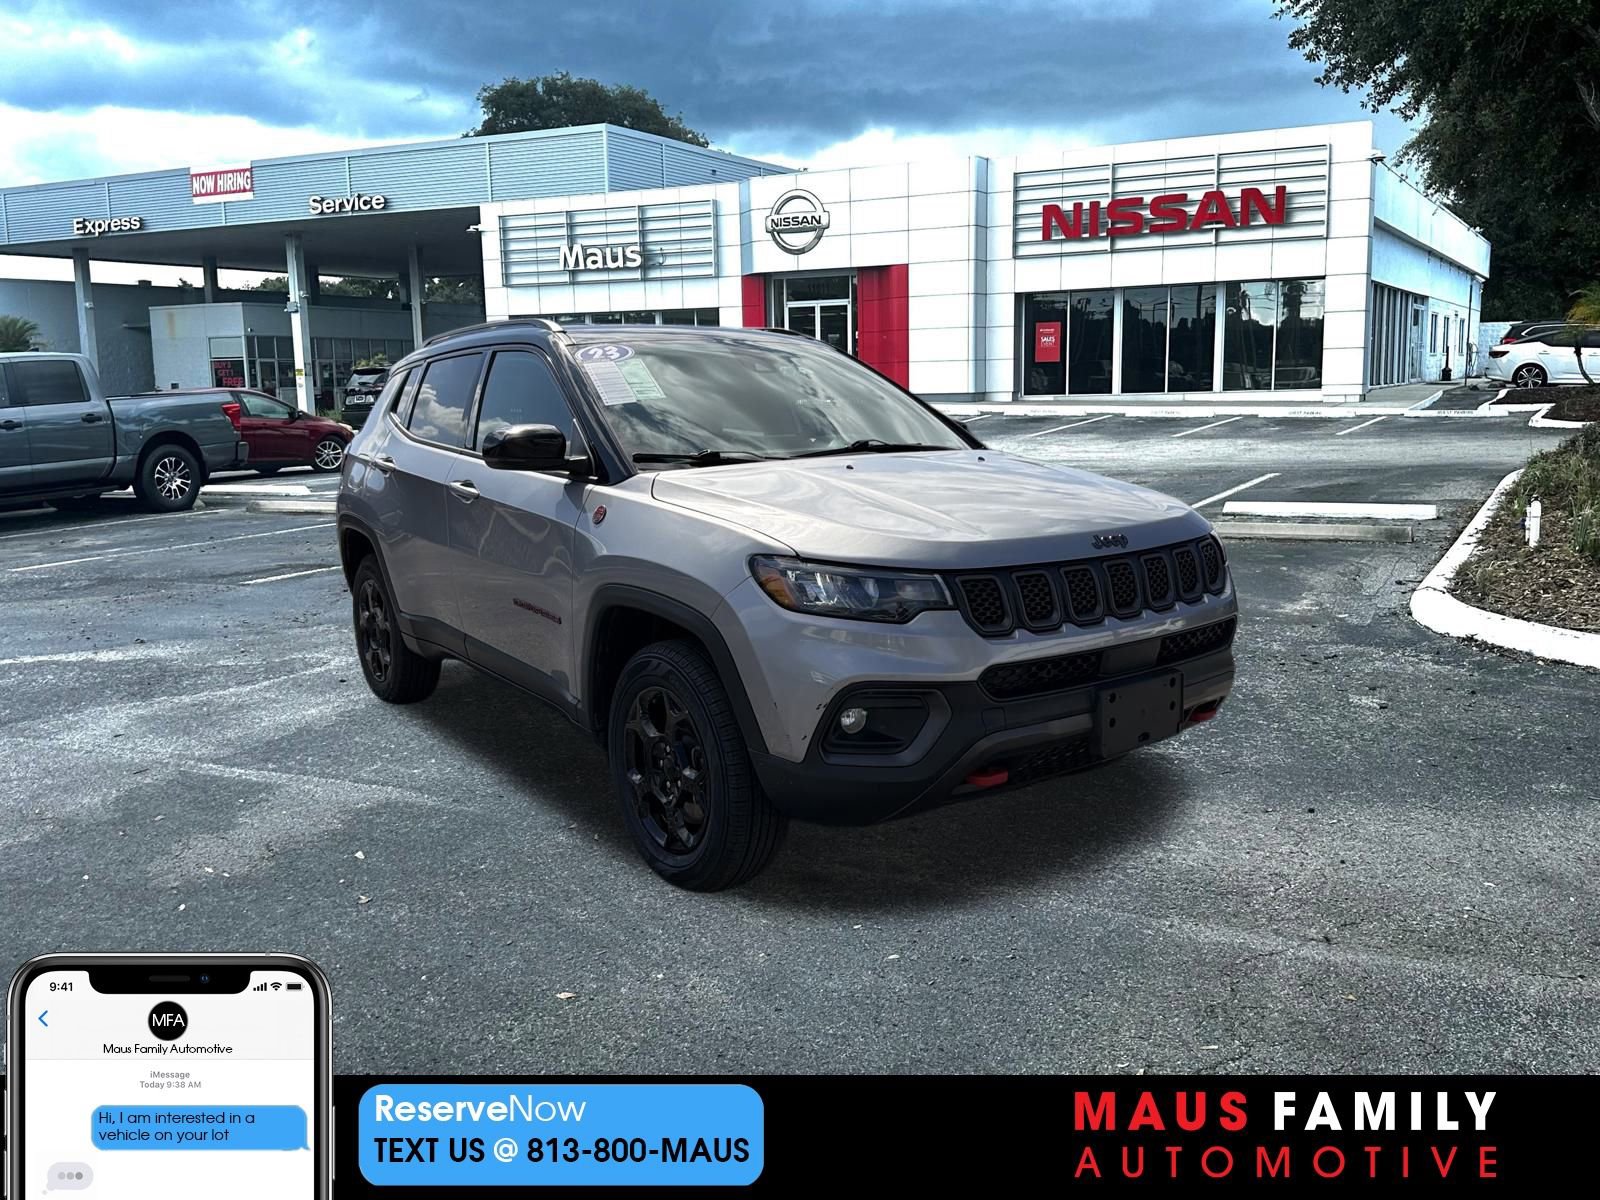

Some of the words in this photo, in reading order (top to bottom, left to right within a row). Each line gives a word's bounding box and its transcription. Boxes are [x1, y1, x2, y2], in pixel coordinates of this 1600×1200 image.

[192, 174, 215, 195] NOW
[217, 171, 251, 192] HIRING
[309, 193, 385, 214] Service
[1042, 185, 1287, 241] NISSAN
[73, 216, 141, 236] Express
[770, 215, 821, 228] NISSAN
[559, 243, 642, 270] Maus
[223, 377, 244, 387] FREE
[1091, 533, 1129, 549] Jeep
